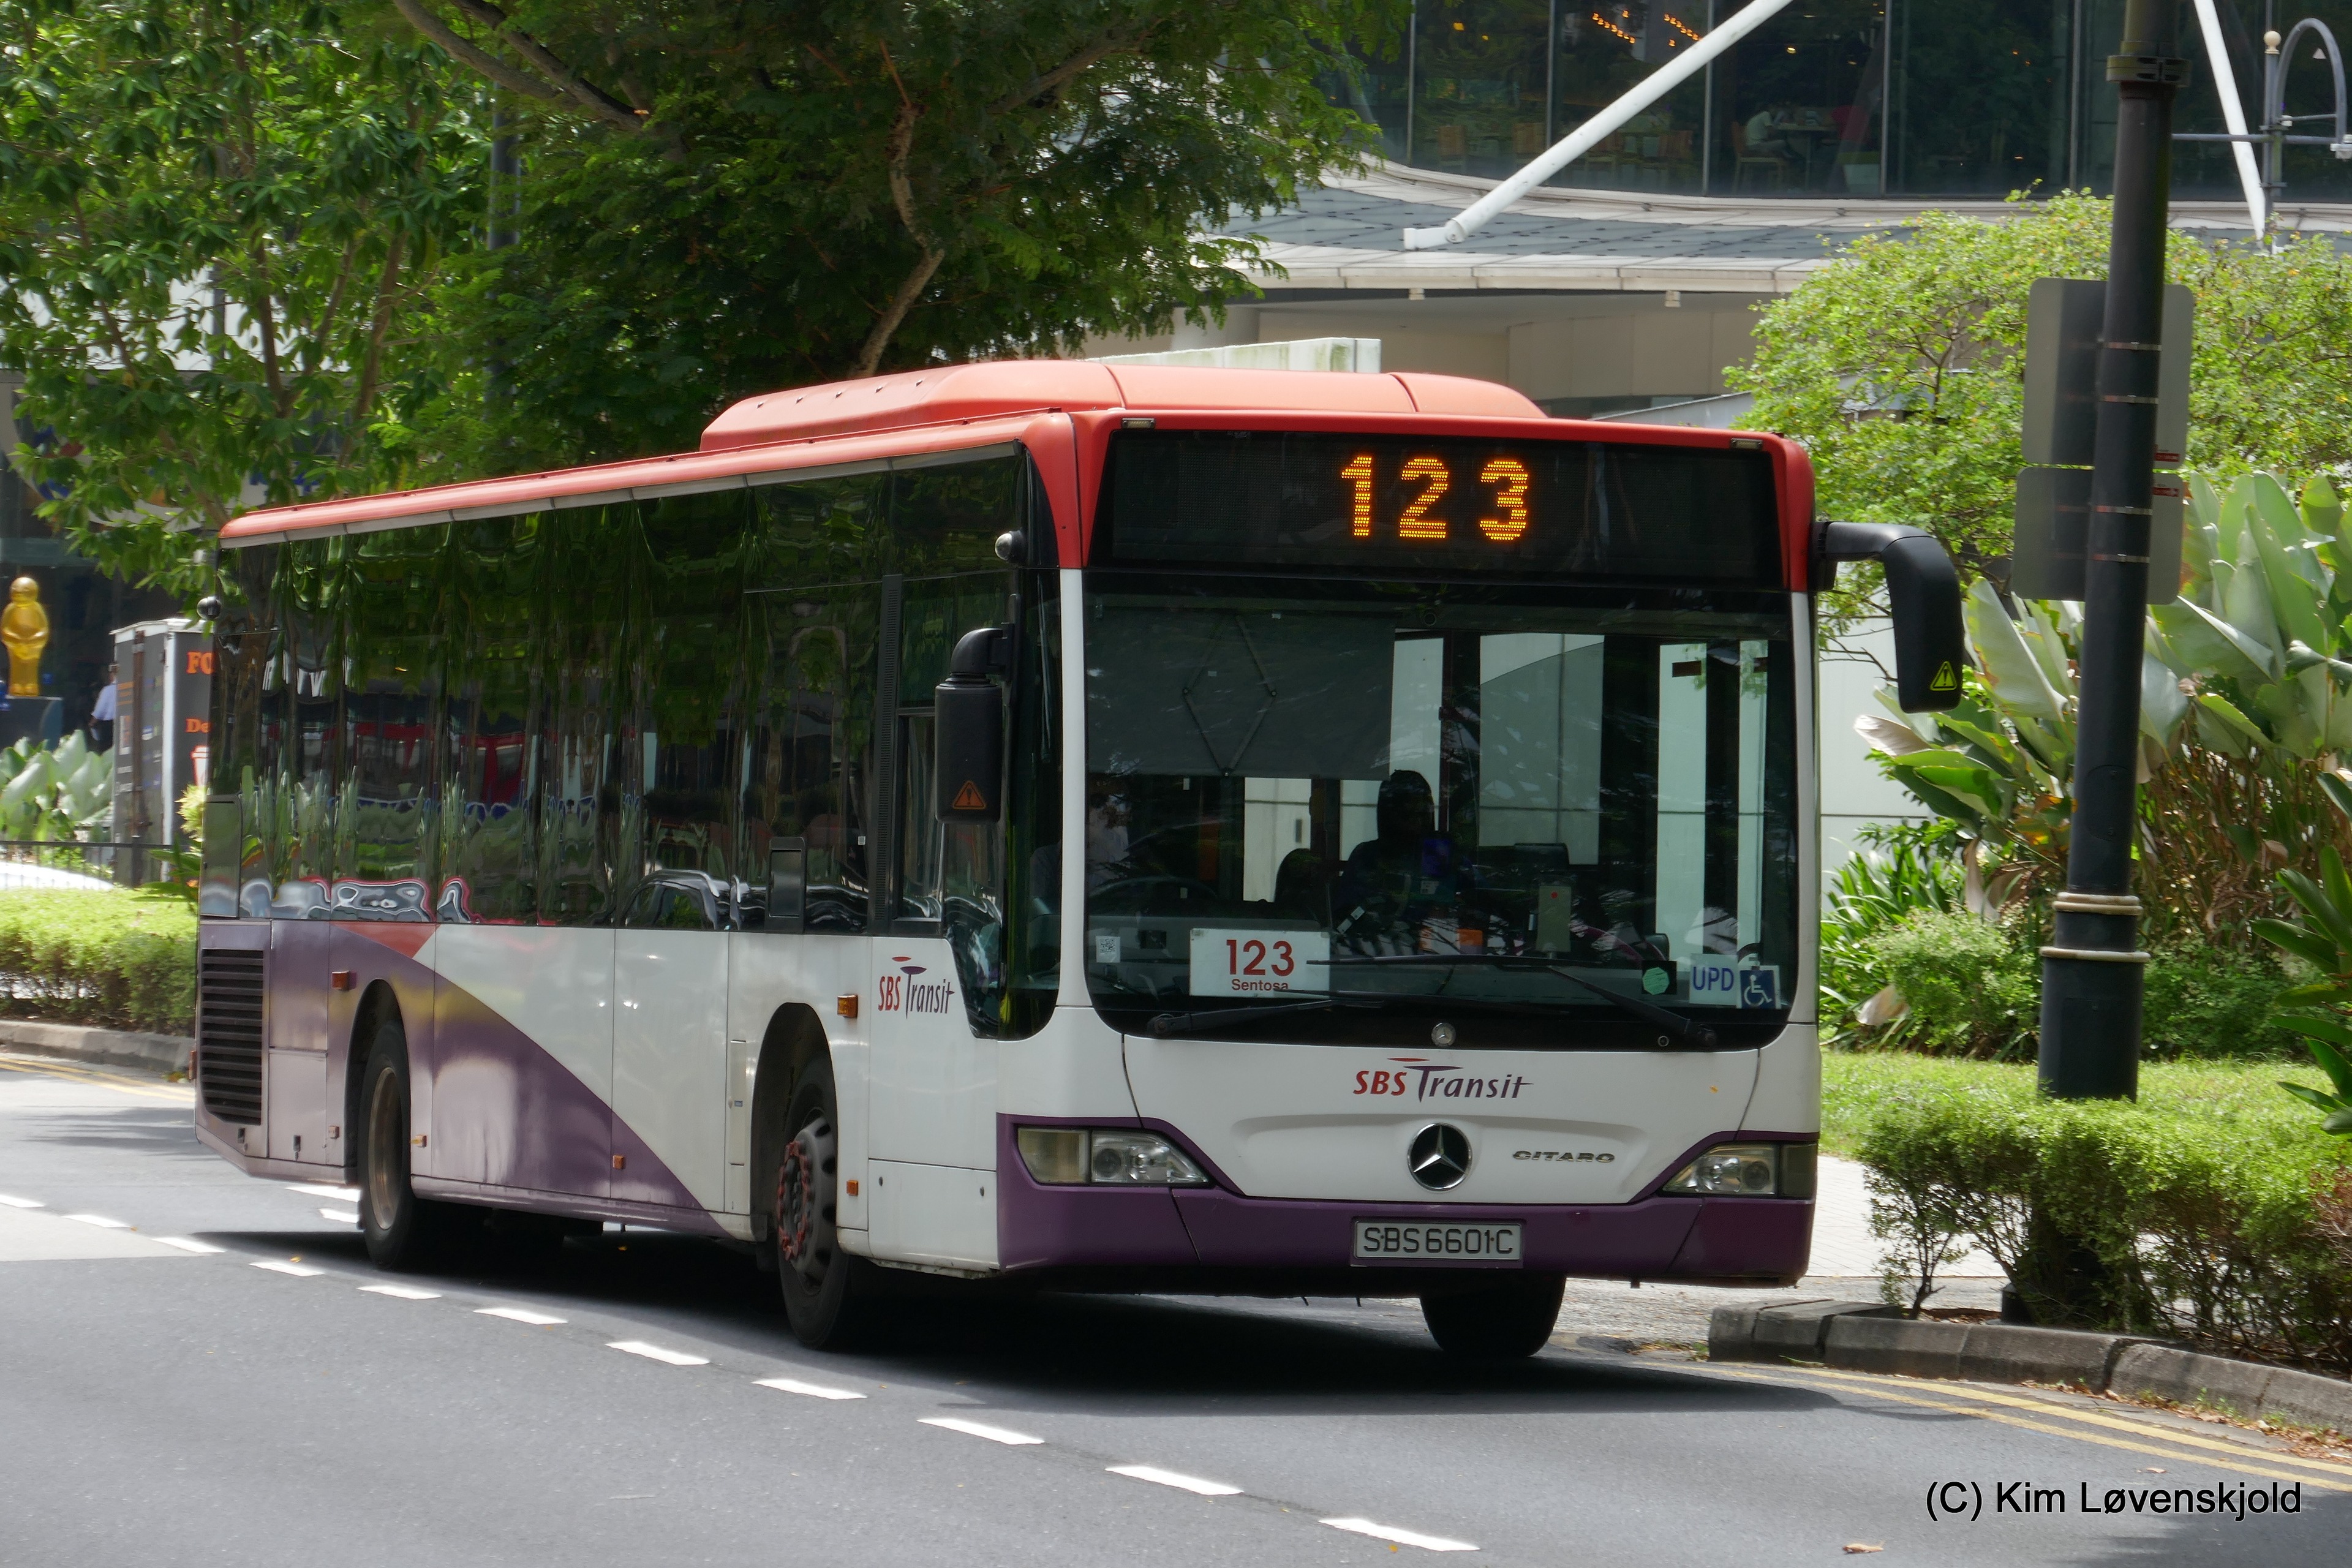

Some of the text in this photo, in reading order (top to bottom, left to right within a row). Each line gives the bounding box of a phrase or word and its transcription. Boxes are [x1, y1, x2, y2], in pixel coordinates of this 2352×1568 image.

[1226, 939, 1294, 976] 123
[878, 966, 955, 1019] SBS Transit
[1231, 978, 1289, 991] Sentosa
[1692, 966, 1734, 991] UPD
[1353, 1066, 1534, 1102] SBS Transit
[1513, 1150, 1615, 1163] CITARO
